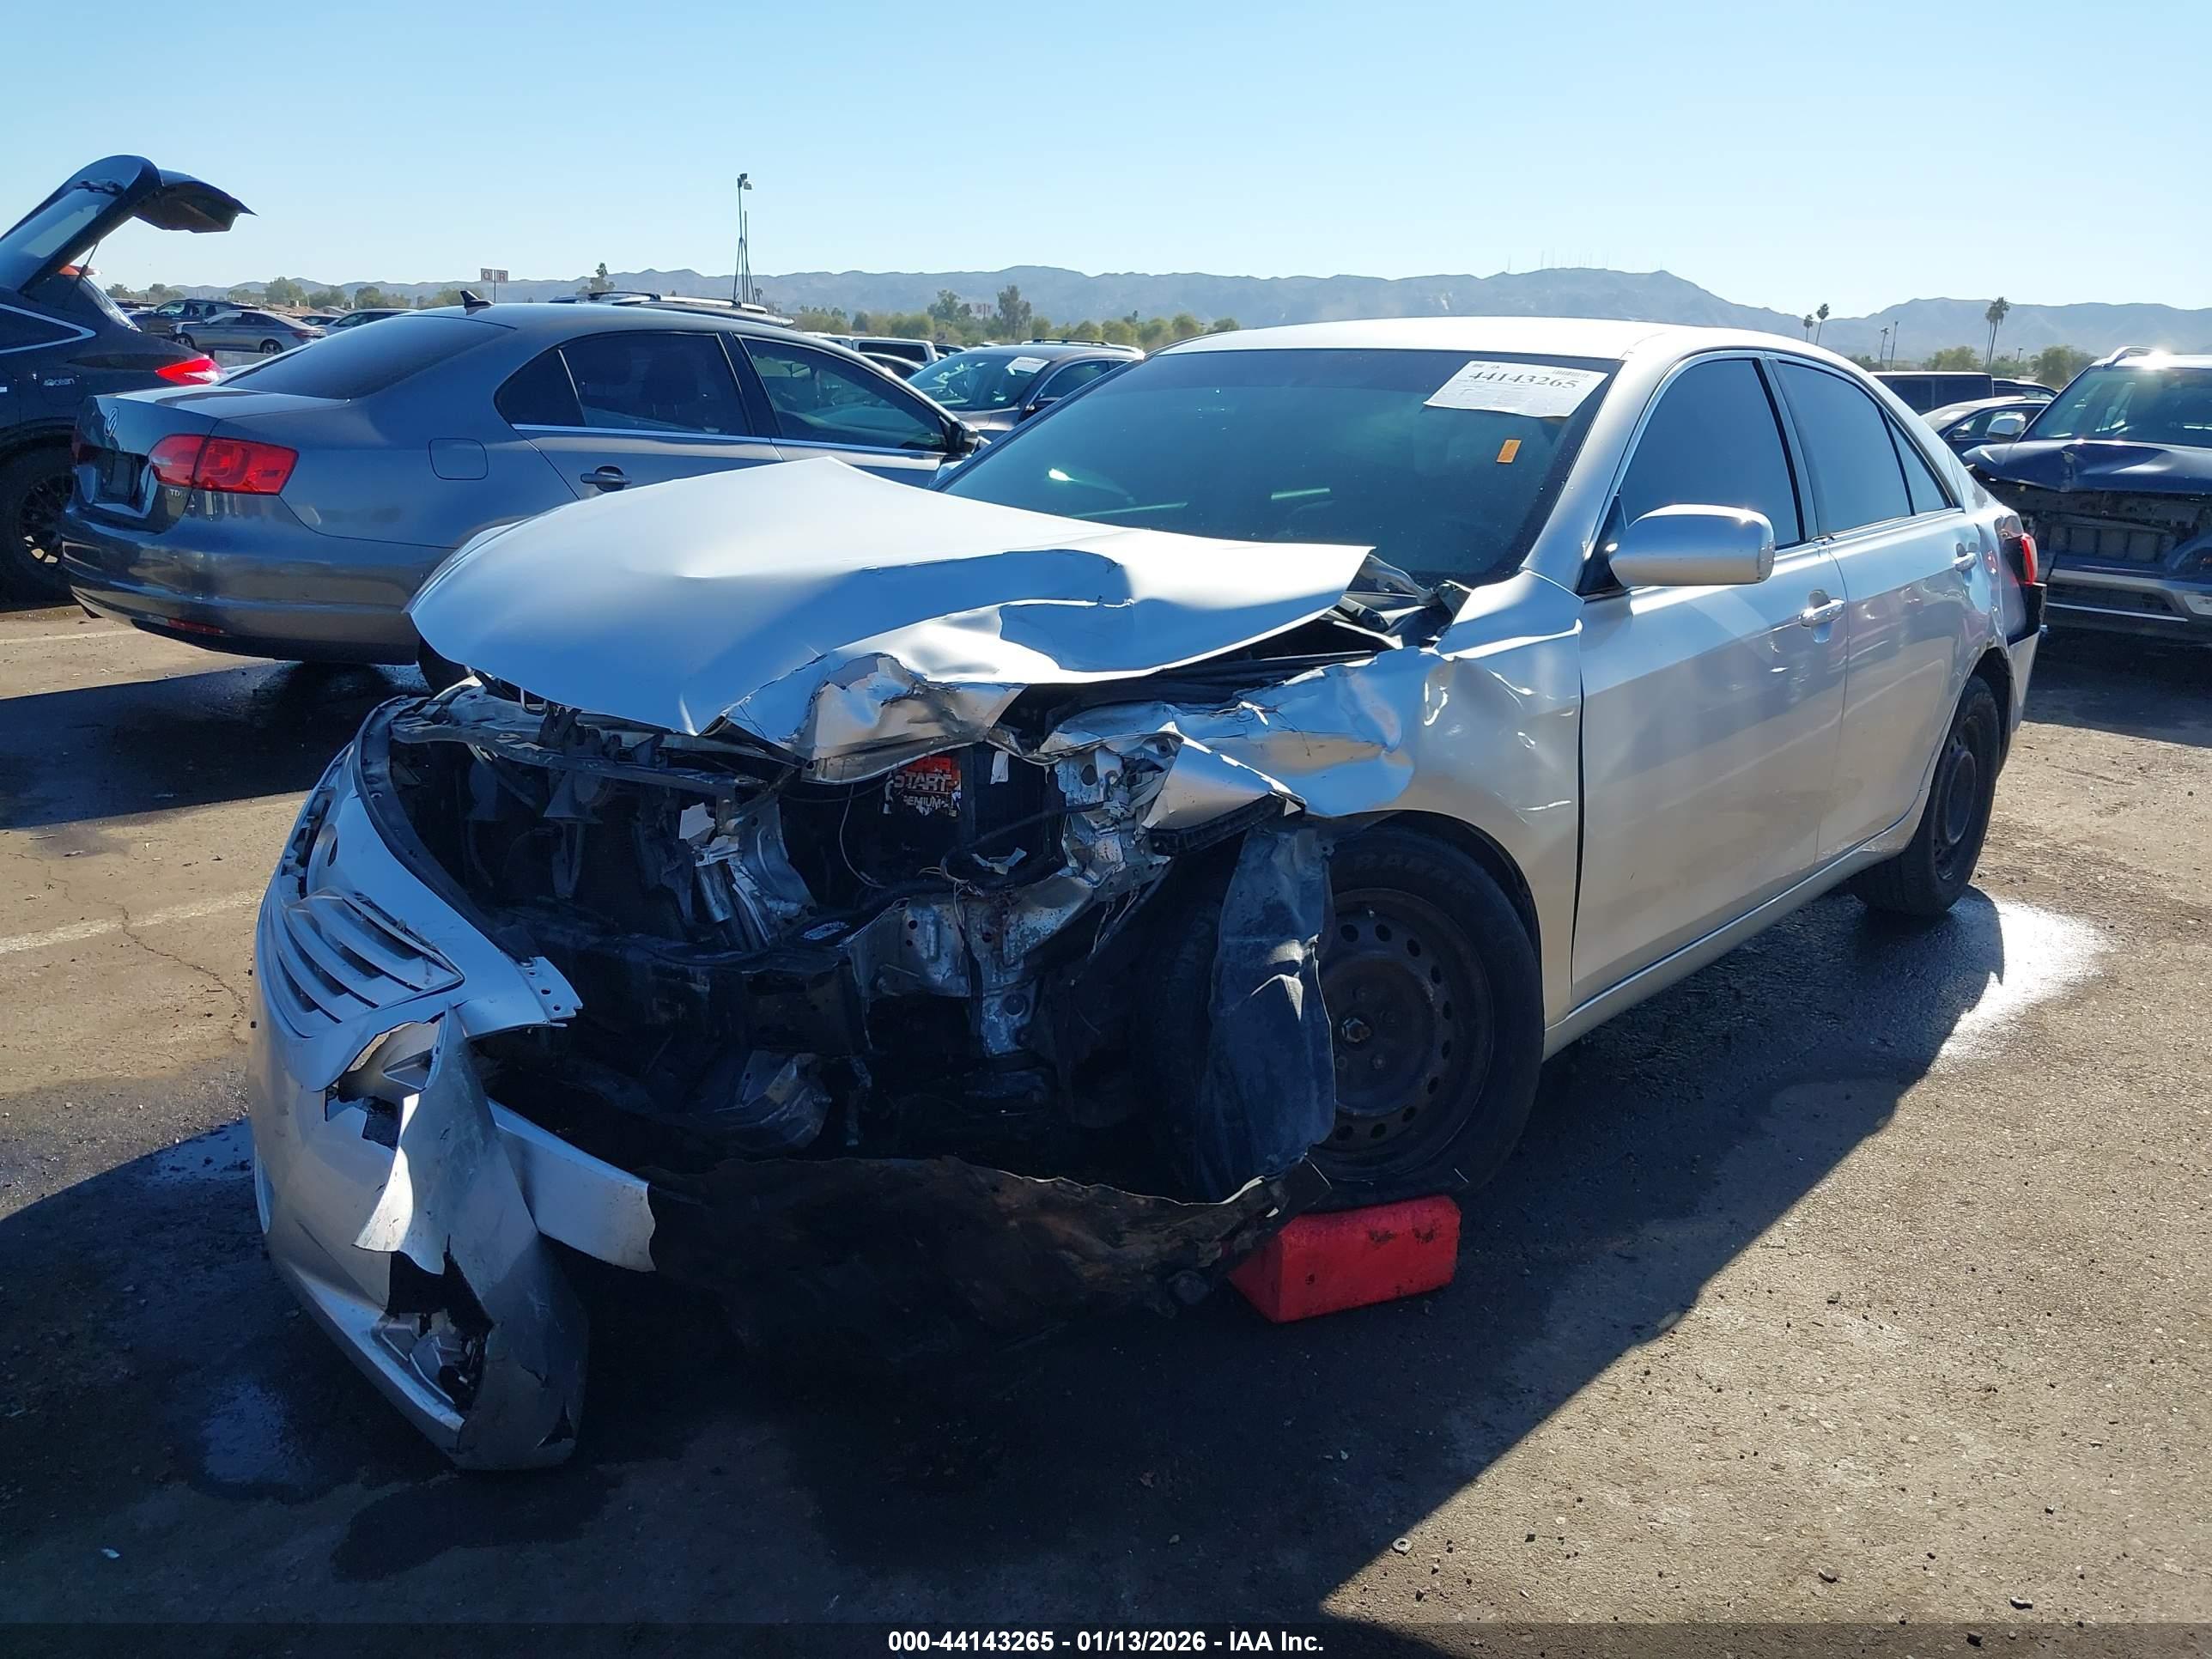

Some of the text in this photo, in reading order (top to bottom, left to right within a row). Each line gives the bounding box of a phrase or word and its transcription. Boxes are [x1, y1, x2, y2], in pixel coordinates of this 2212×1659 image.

[1468, 371, 1580, 389] 44143265
[894, 772, 952, 792] START
[902, 794, 942, 810] EMIUM
